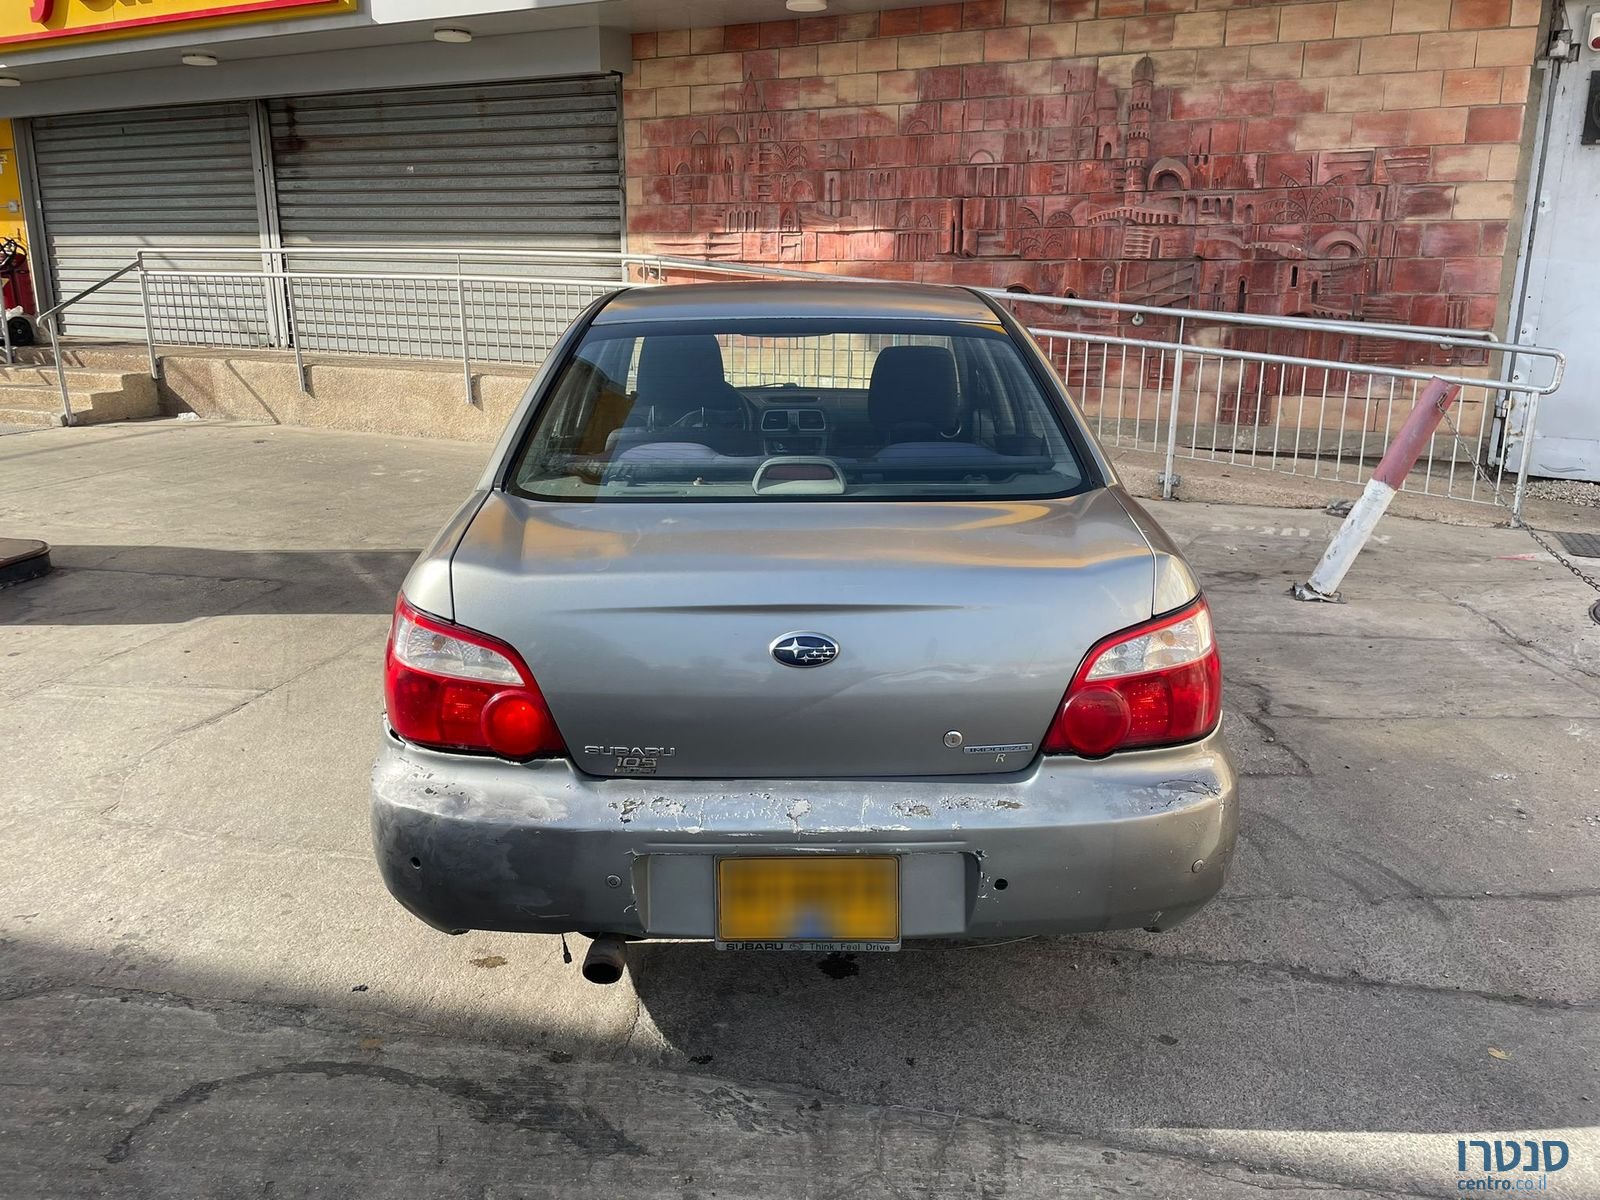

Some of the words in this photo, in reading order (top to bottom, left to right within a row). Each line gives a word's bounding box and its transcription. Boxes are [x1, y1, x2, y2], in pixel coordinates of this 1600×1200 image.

[584, 745, 676, 757] SUBARU
[995, 753, 1006, 763] R
[726, 942, 784, 951] SUBARU
